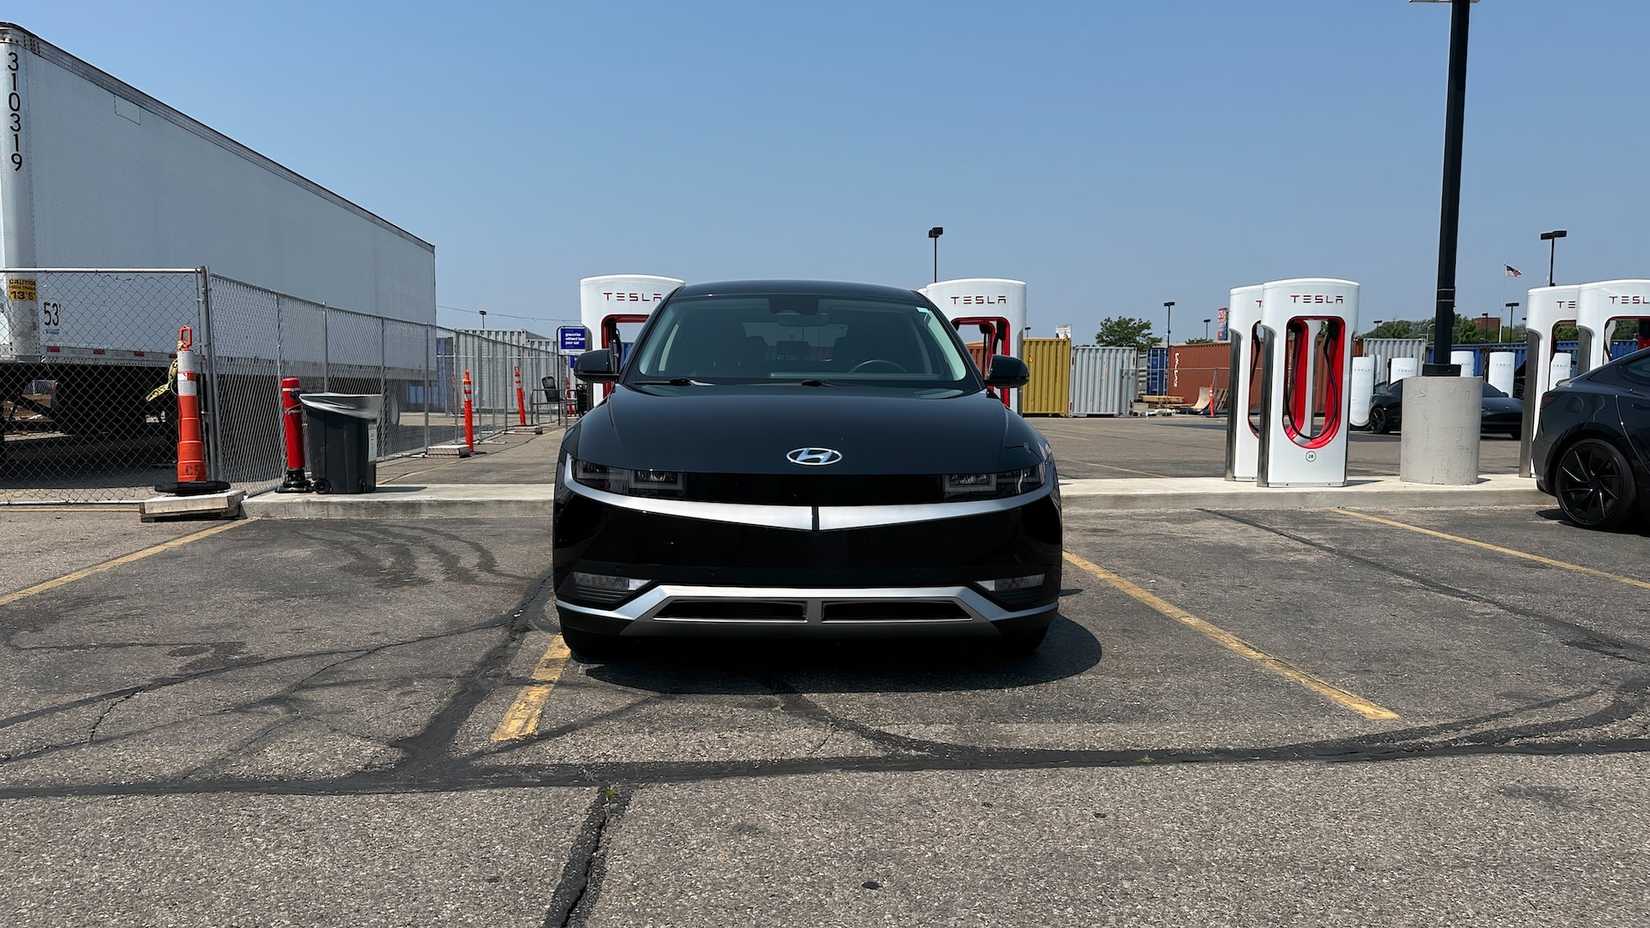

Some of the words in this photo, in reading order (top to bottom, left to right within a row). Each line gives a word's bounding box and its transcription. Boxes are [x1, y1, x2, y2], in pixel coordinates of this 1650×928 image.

[8, 52, 23, 172] 310319
[603, 292, 662, 302] TESLA
[950, 295, 1007, 305] TESLA
[1290, 295, 1344, 304] TESLA
[1608, 296, 1650, 304] TESL
